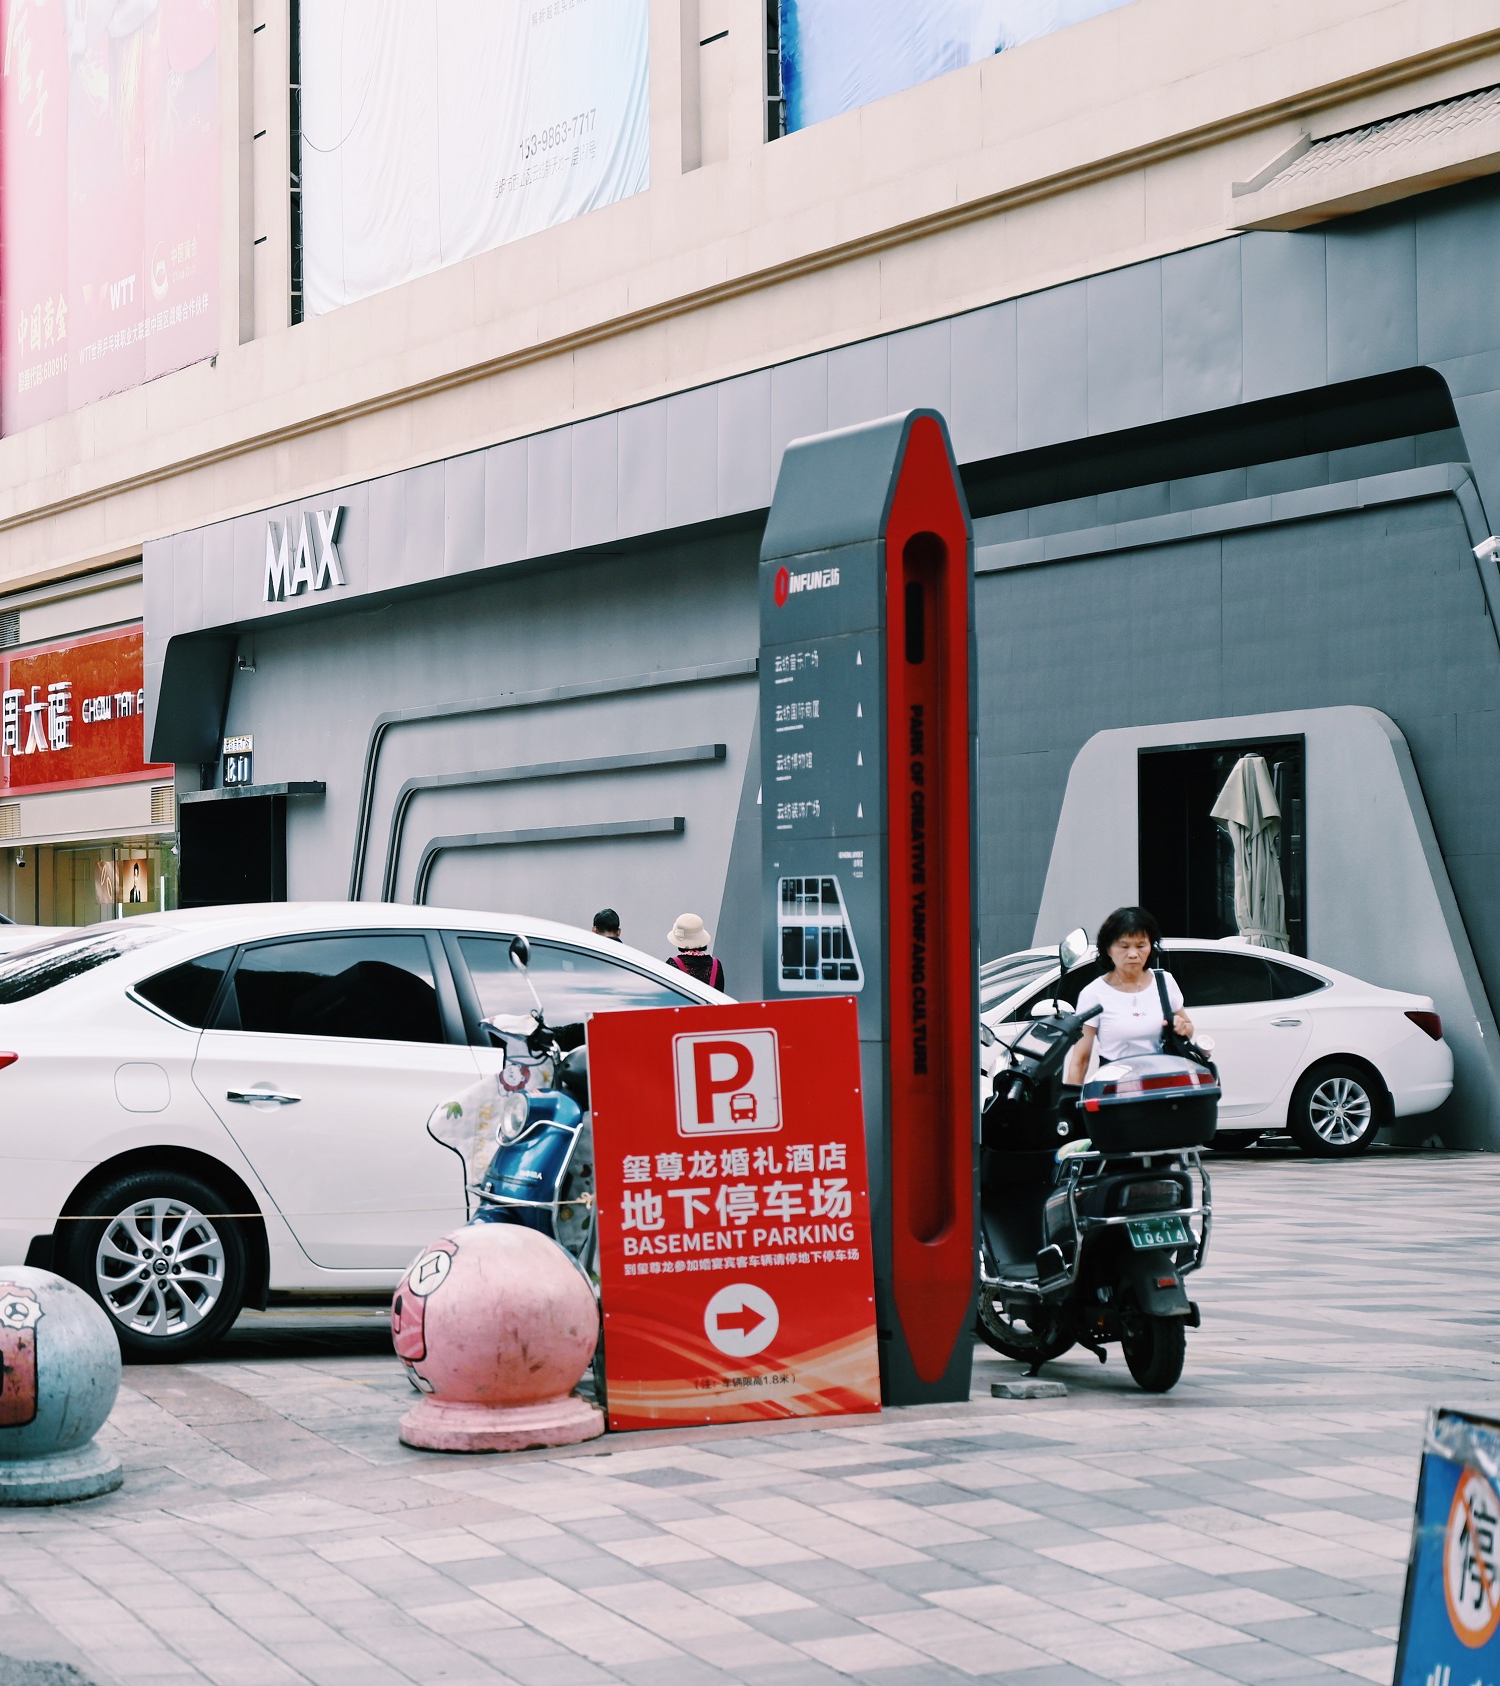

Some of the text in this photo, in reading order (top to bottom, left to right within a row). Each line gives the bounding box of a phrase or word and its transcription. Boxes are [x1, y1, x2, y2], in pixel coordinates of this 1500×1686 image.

[109, 274, 135, 311] WTT
[263, 506, 345, 602] MAX
[2, 682, 73, 757] 周大福
[82, 695, 112, 723] CHOW
[910, 704, 924, 756] PARK
[911, 761, 925, 786] OF
[911, 791, 926, 885] CREATIVE
[621, 1142, 847, 1183] 玺尊龙婚礼酒店
[620, 1178, 854, 1232] 地下停车场
[623, 1222, 855, 1257] BASEMENT PARKING
